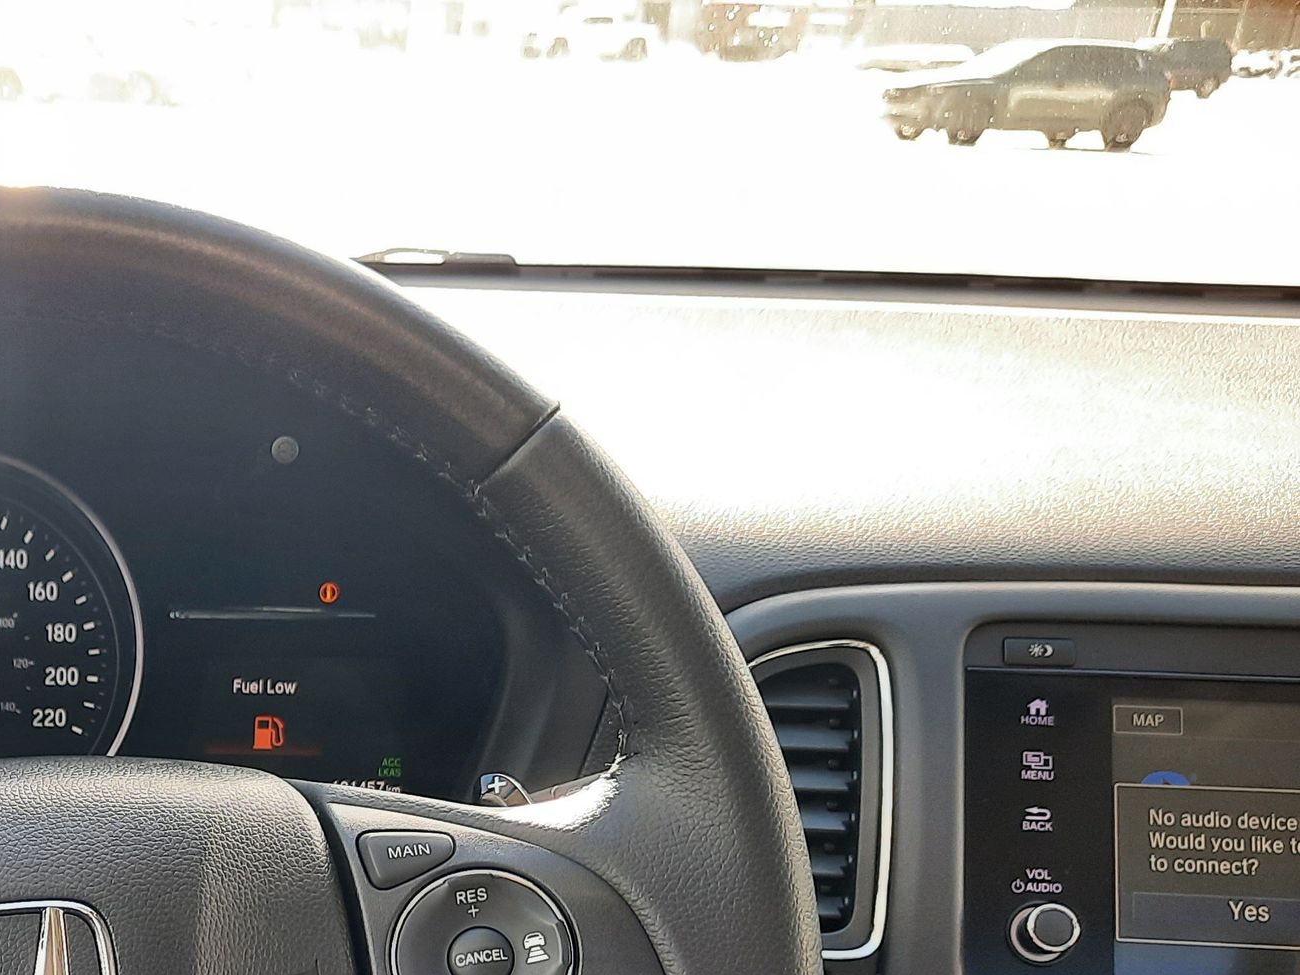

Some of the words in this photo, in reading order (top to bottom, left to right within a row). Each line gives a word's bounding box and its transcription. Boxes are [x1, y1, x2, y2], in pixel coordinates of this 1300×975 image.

[28, 581, 59, 602] 160
[46, 623, 77, 643] 180
[44, 666, 79, 686] 200
[233, 678, 263, 694] Fuel
[267, 679, 297, 694] Low
[32, 708, 67, 728] 220
[1020, 715, 1054, 726] HOME
[1132, 713, 1164, 728] MAP
[382, 758, 401, 767] ACC
[378, 768, 401, 777] LKAS
[1021, 770, 1054, 781] MENU
[1022, 821, 1053, 831] BACK
[1149, 808, 1175, 826] No
[1181, 811, 1232, 829] audio
[1237, 812, 1298, 831] device
[1149, 831, 1206, 850] Would
[1210, 838, 1245, 853] you
[1251, 836, 1285, 853] like
[387, 843, 431, 859] MAIN
[1150, 854, 1168, 872] to
[1174, 857, 1259, 875] connect?
[1026, 869, 1051, 880] VOL
[456, 887, 488, 905] RES
[1026, 882, 1062, 894] AUDIO
[1228, 900, 1270, 922] Yes
[454, 948, 508, 967] CANCEL
